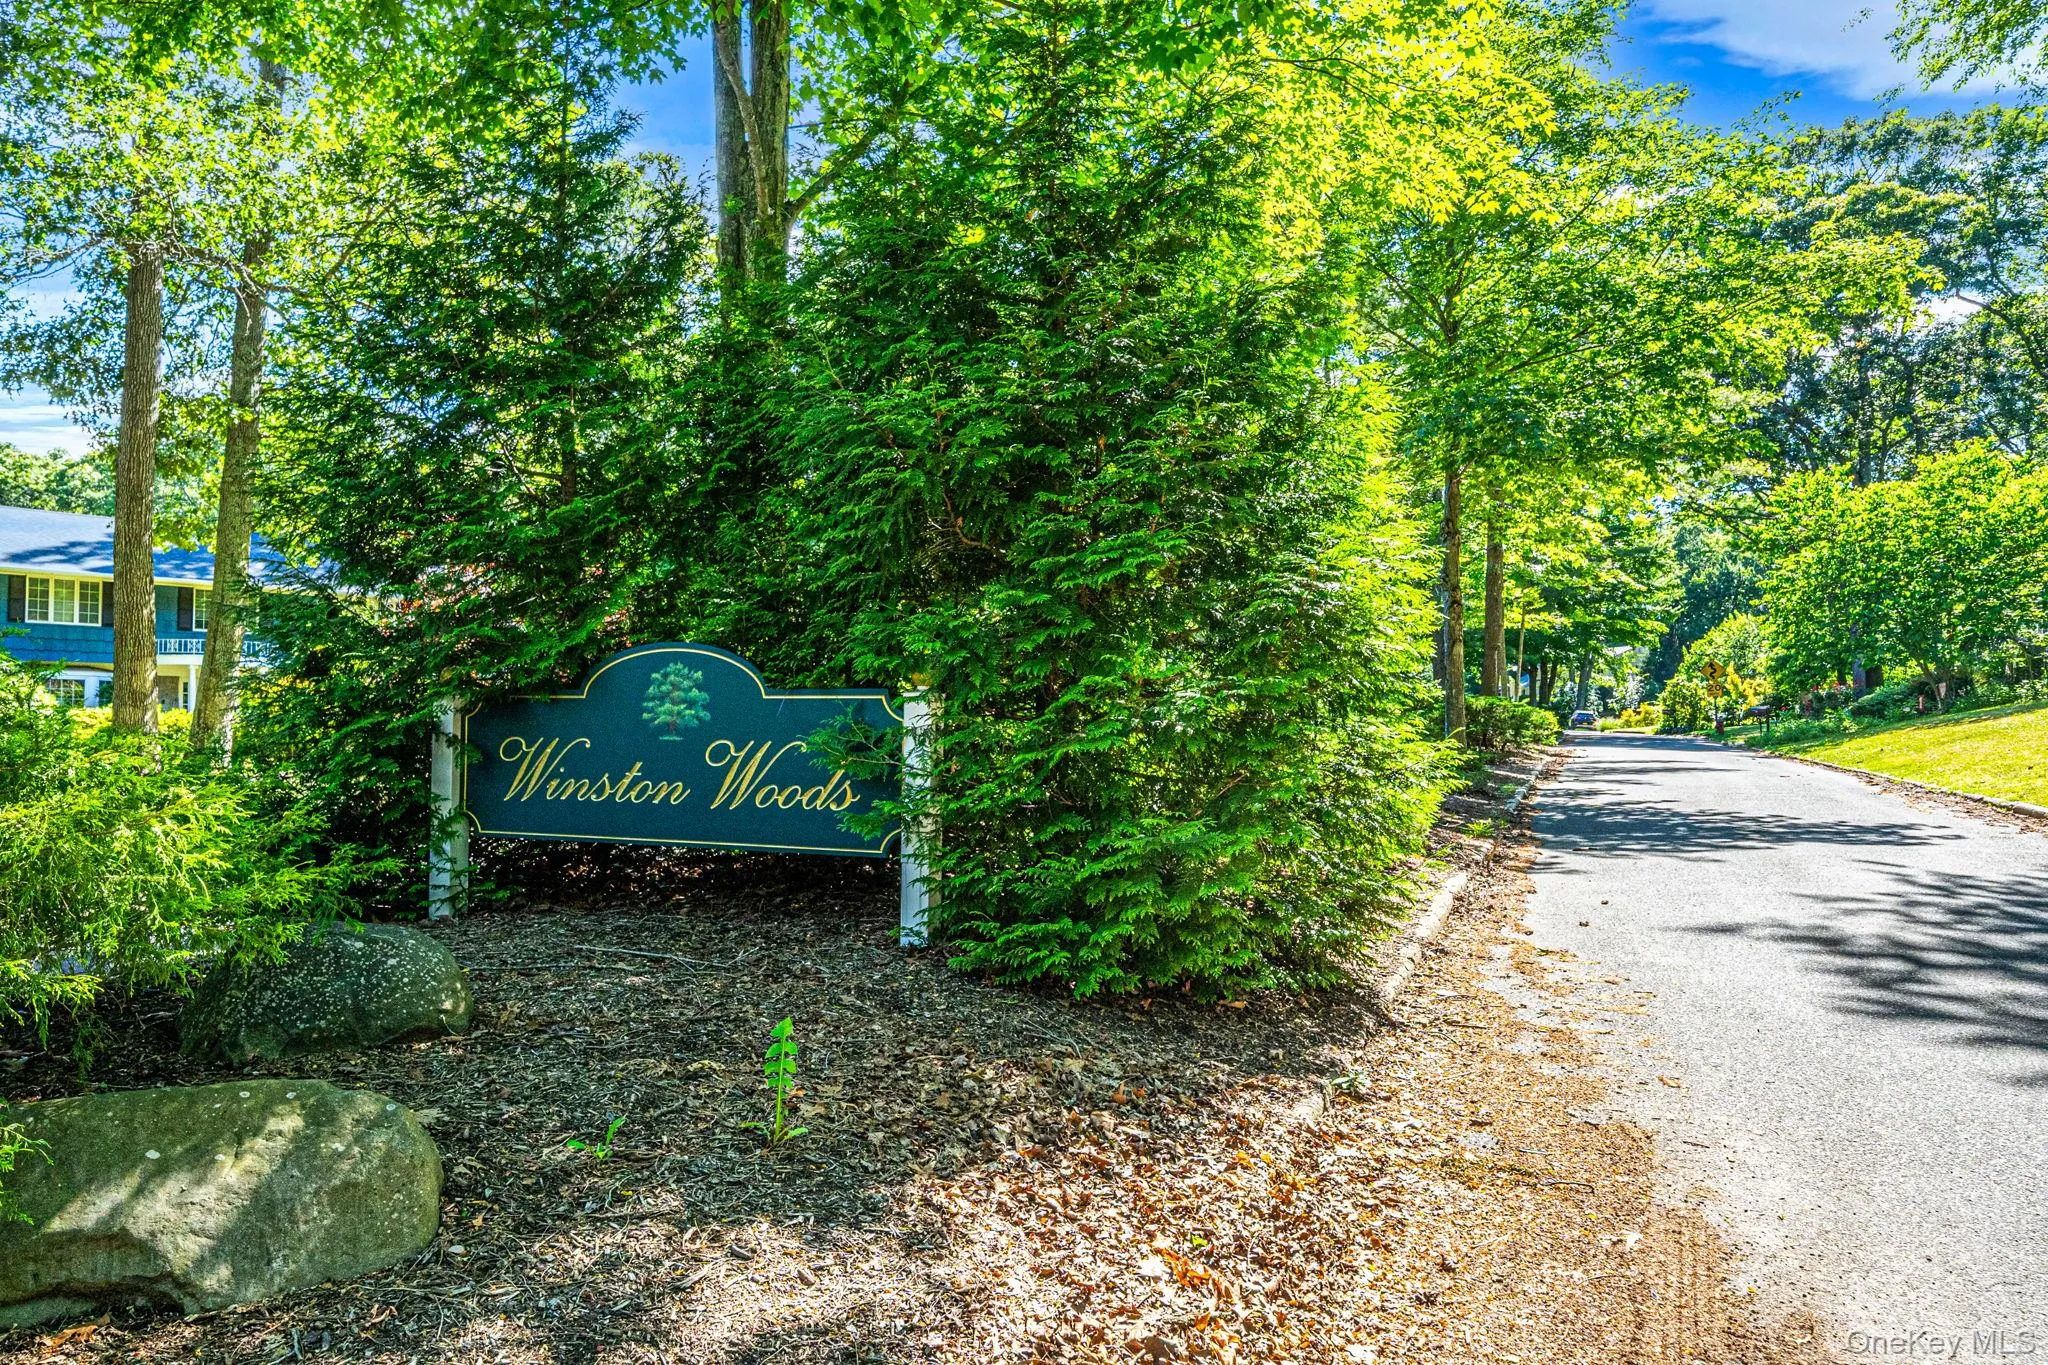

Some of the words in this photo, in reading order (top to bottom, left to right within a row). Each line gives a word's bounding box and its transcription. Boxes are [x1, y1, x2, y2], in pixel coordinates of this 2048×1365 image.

[1707, 684, 1721, 692] 20
[499, 736, 691, 805] Winston
[705, 739, 861, 811] Woods
